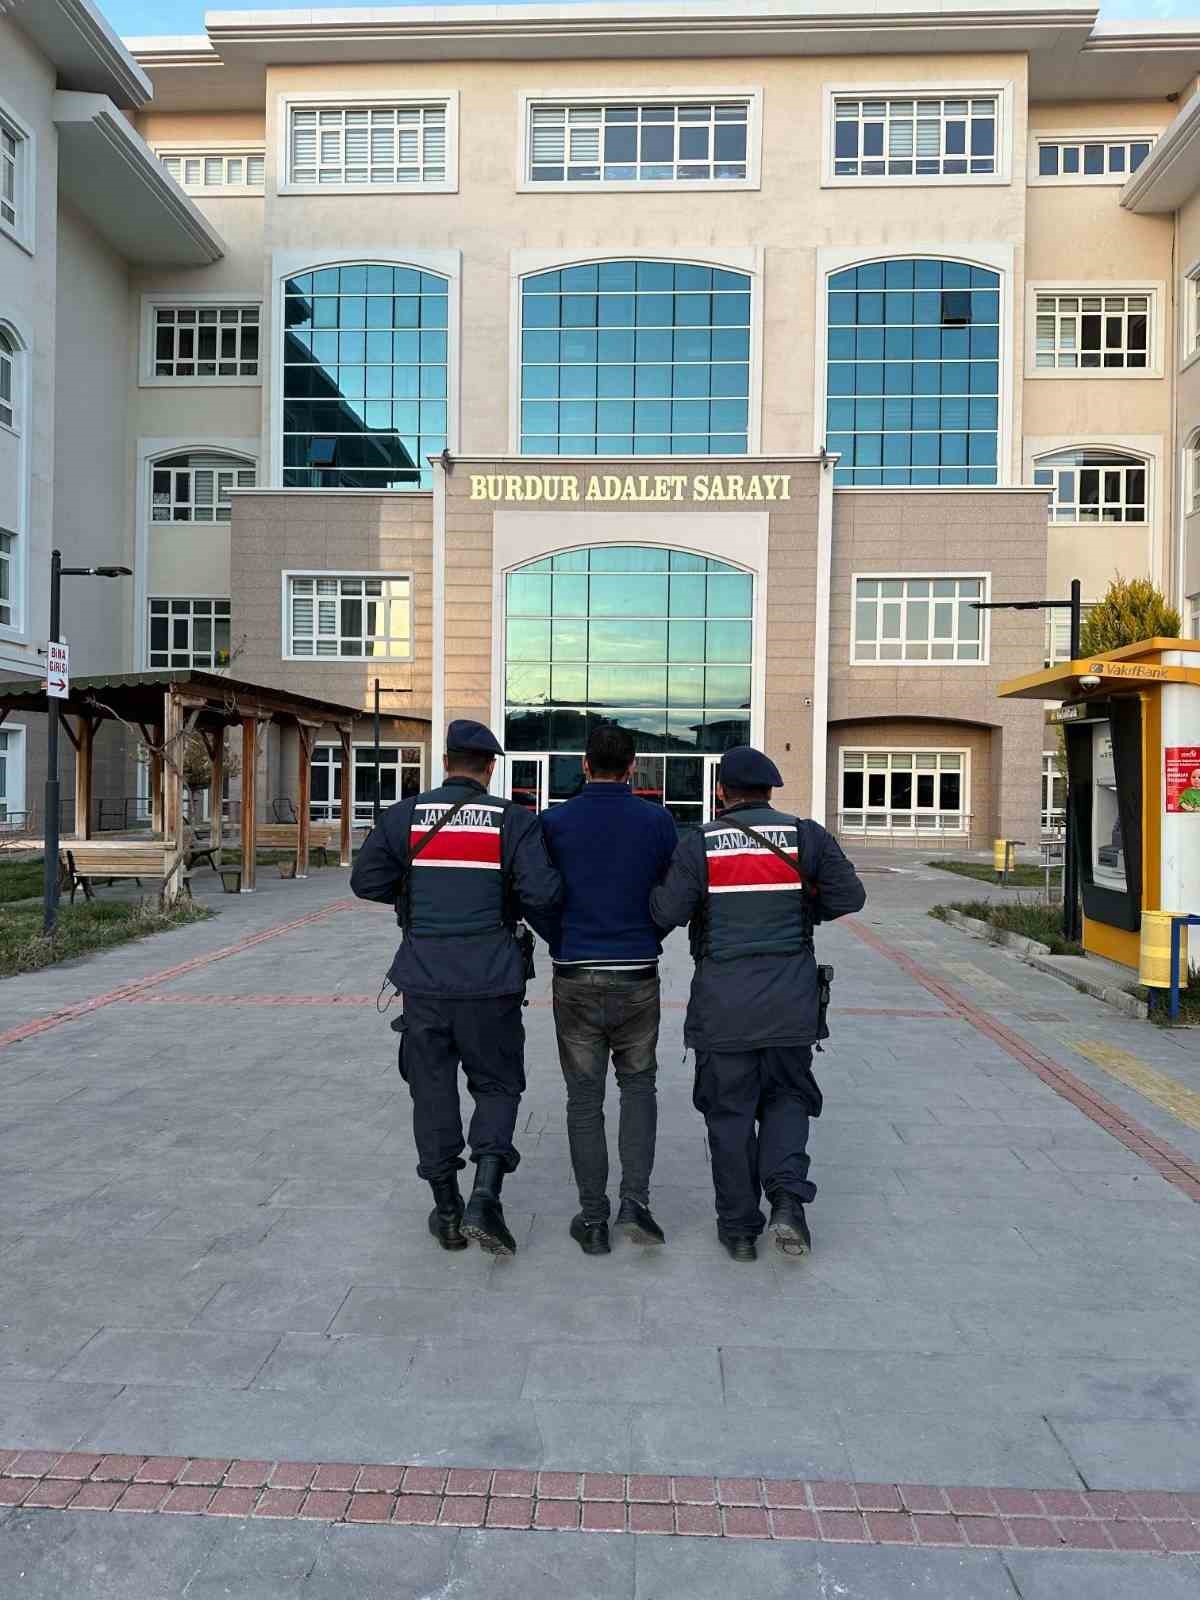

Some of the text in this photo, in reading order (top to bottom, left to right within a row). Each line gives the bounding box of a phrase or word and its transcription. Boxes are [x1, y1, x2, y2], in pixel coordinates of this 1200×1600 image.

[470, 474, 792, 501] BURDUR ADALET SARAYI
